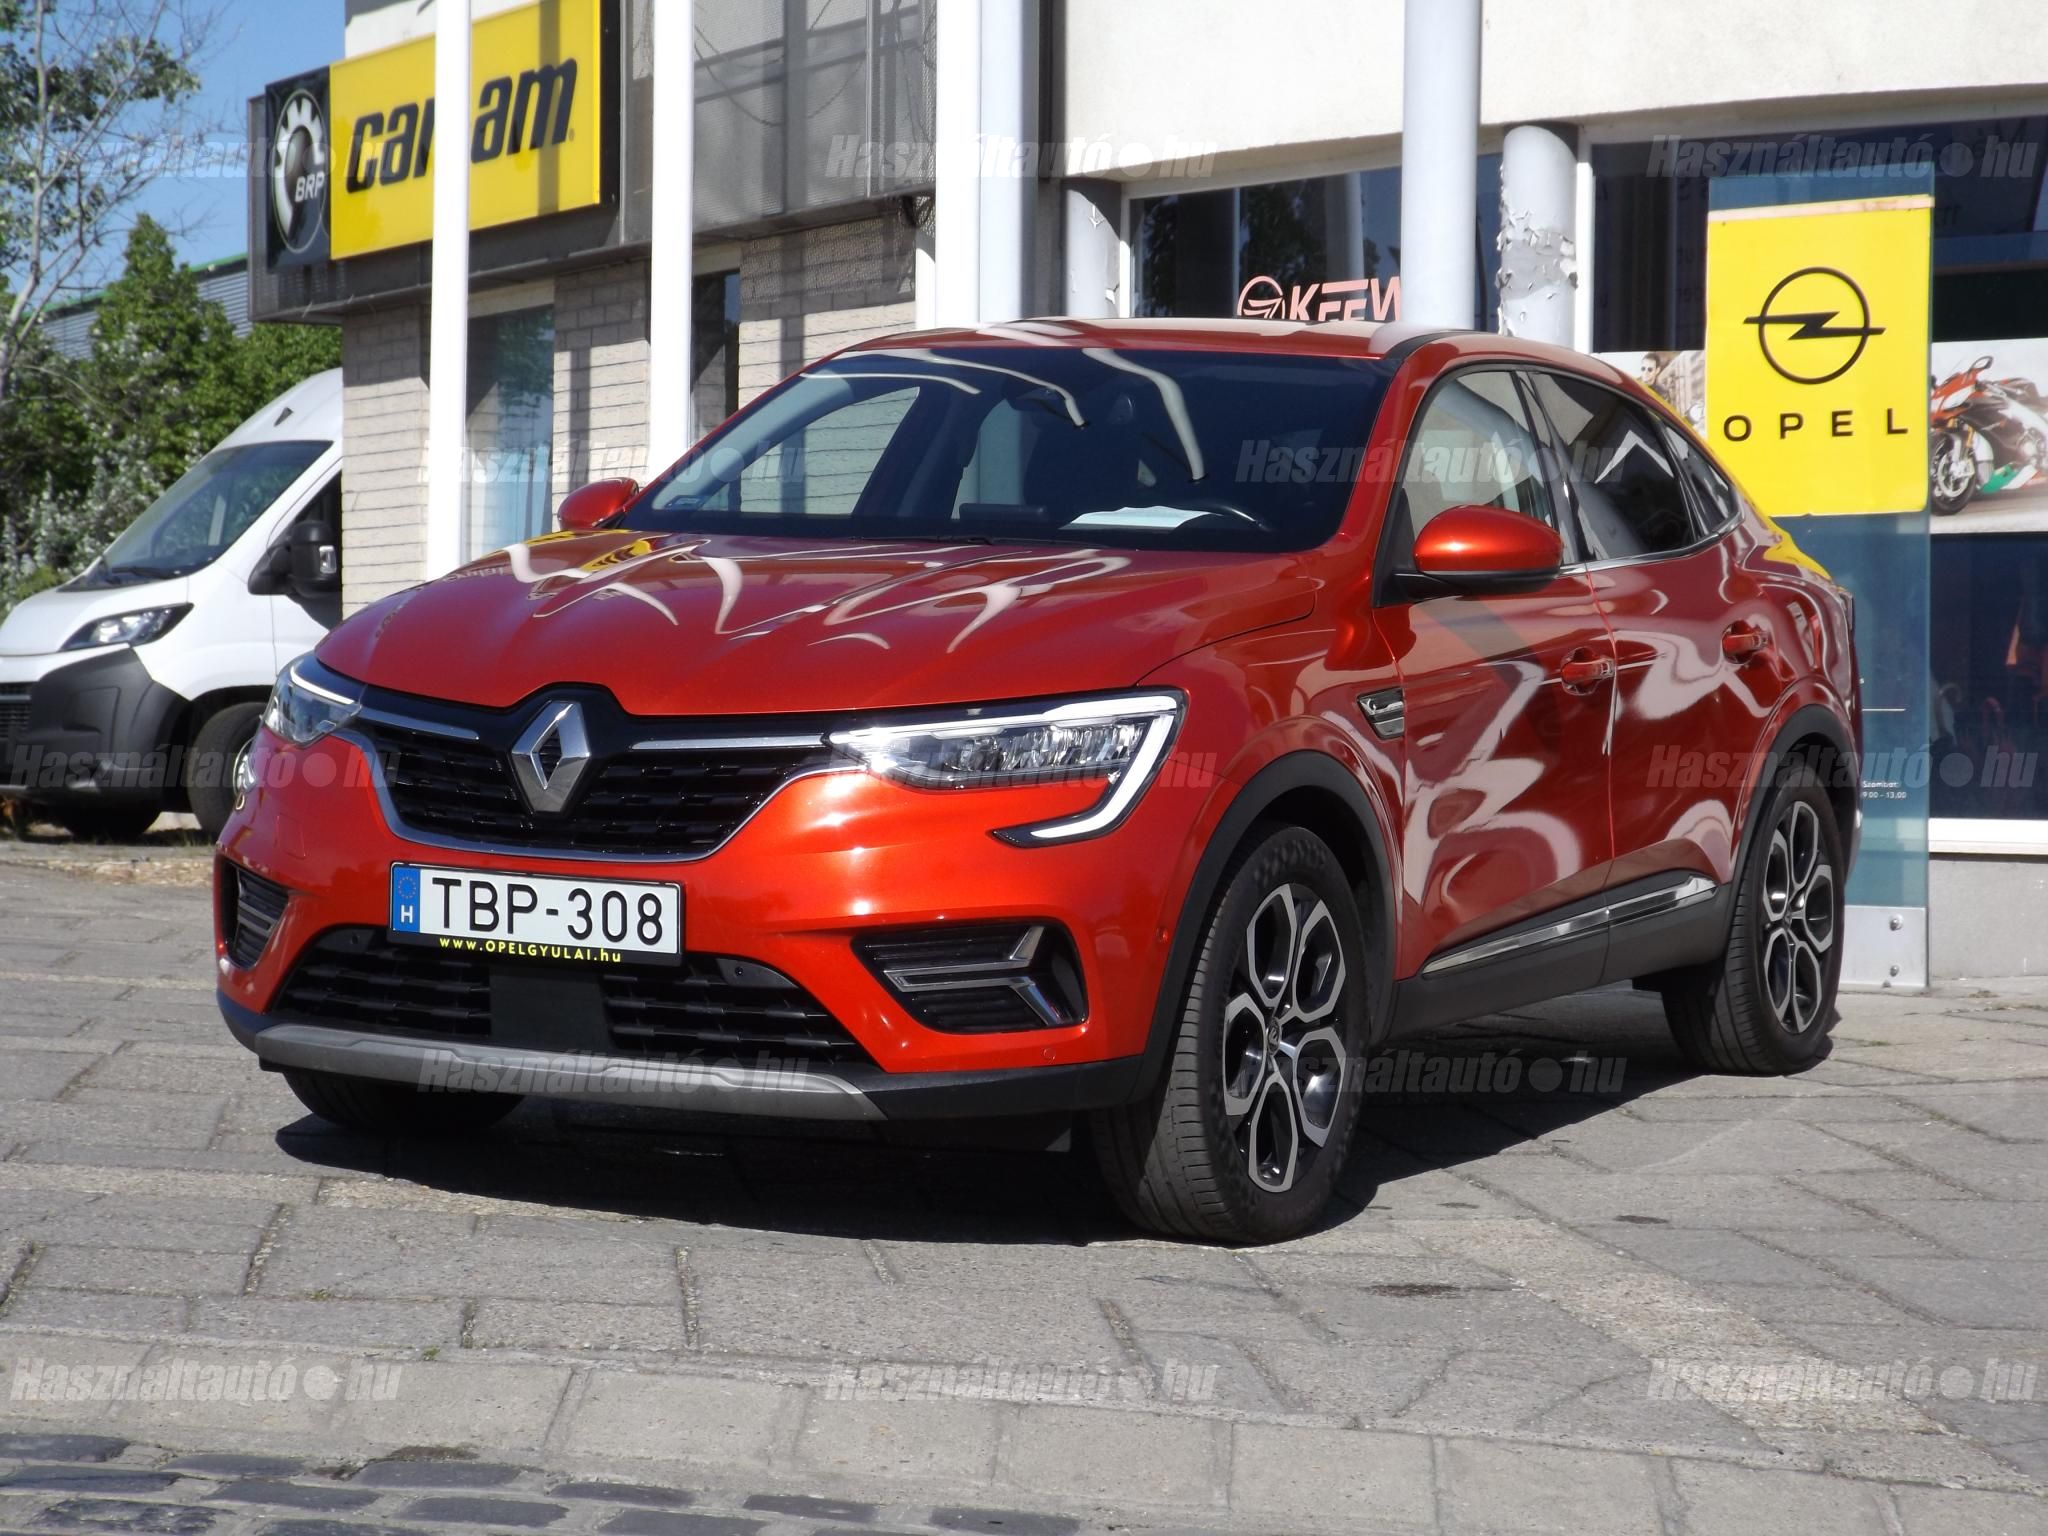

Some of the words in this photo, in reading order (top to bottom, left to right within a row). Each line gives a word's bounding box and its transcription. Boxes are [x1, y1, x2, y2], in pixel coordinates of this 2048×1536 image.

[295, 170, 326, 203] BRP
[1723, 408, 1909, 442] OPEL
[431, 877, 664, 946] TBP-308
[438, 937, 622, 962] www.OPELGYULAI.hu
